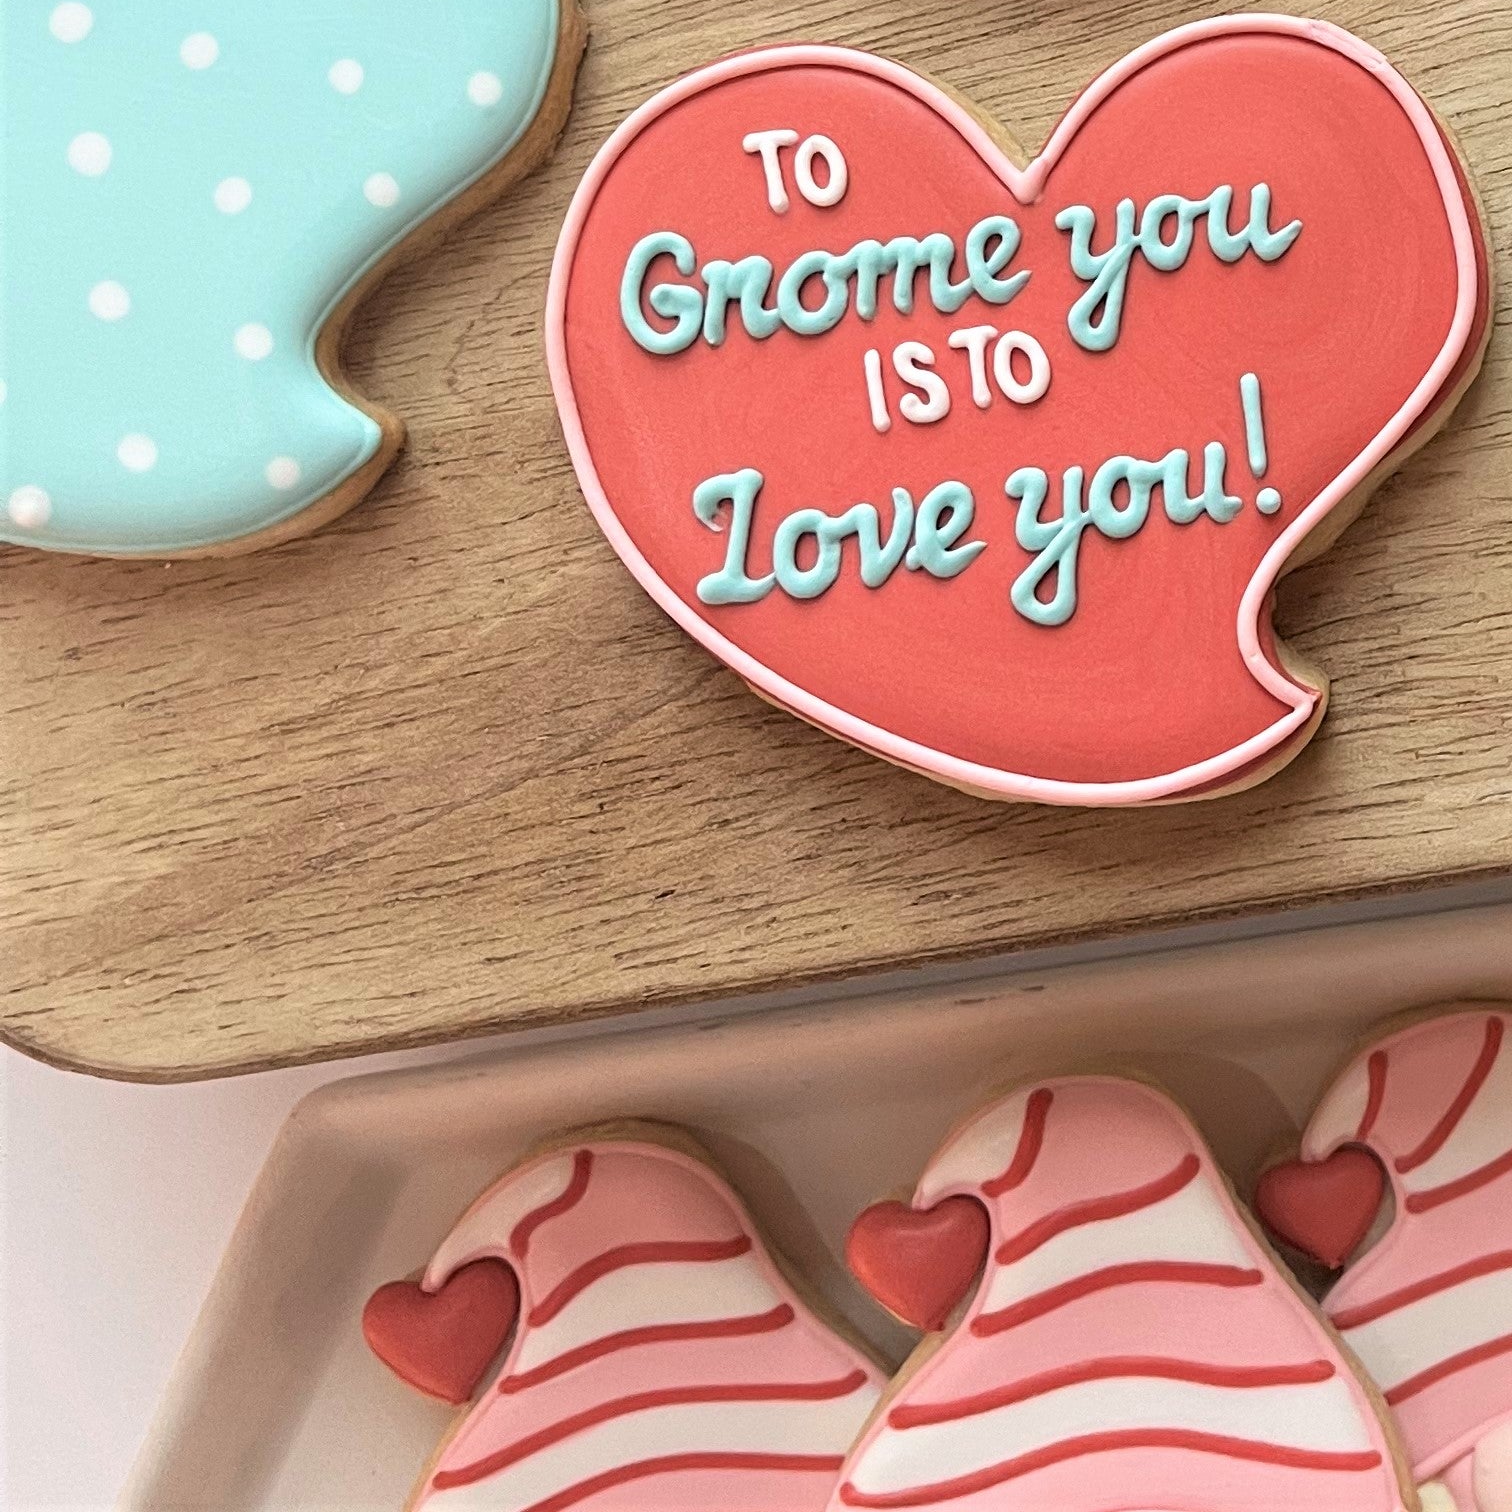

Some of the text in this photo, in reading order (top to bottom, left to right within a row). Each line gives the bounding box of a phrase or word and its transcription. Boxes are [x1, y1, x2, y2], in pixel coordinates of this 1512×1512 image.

[742, 128, 849, 214] TO
[619, 181, 1304, 356] Gnome you
[863, 324, 1051, 432] IS TO
[692, 371, 1284, 627] Love you!
